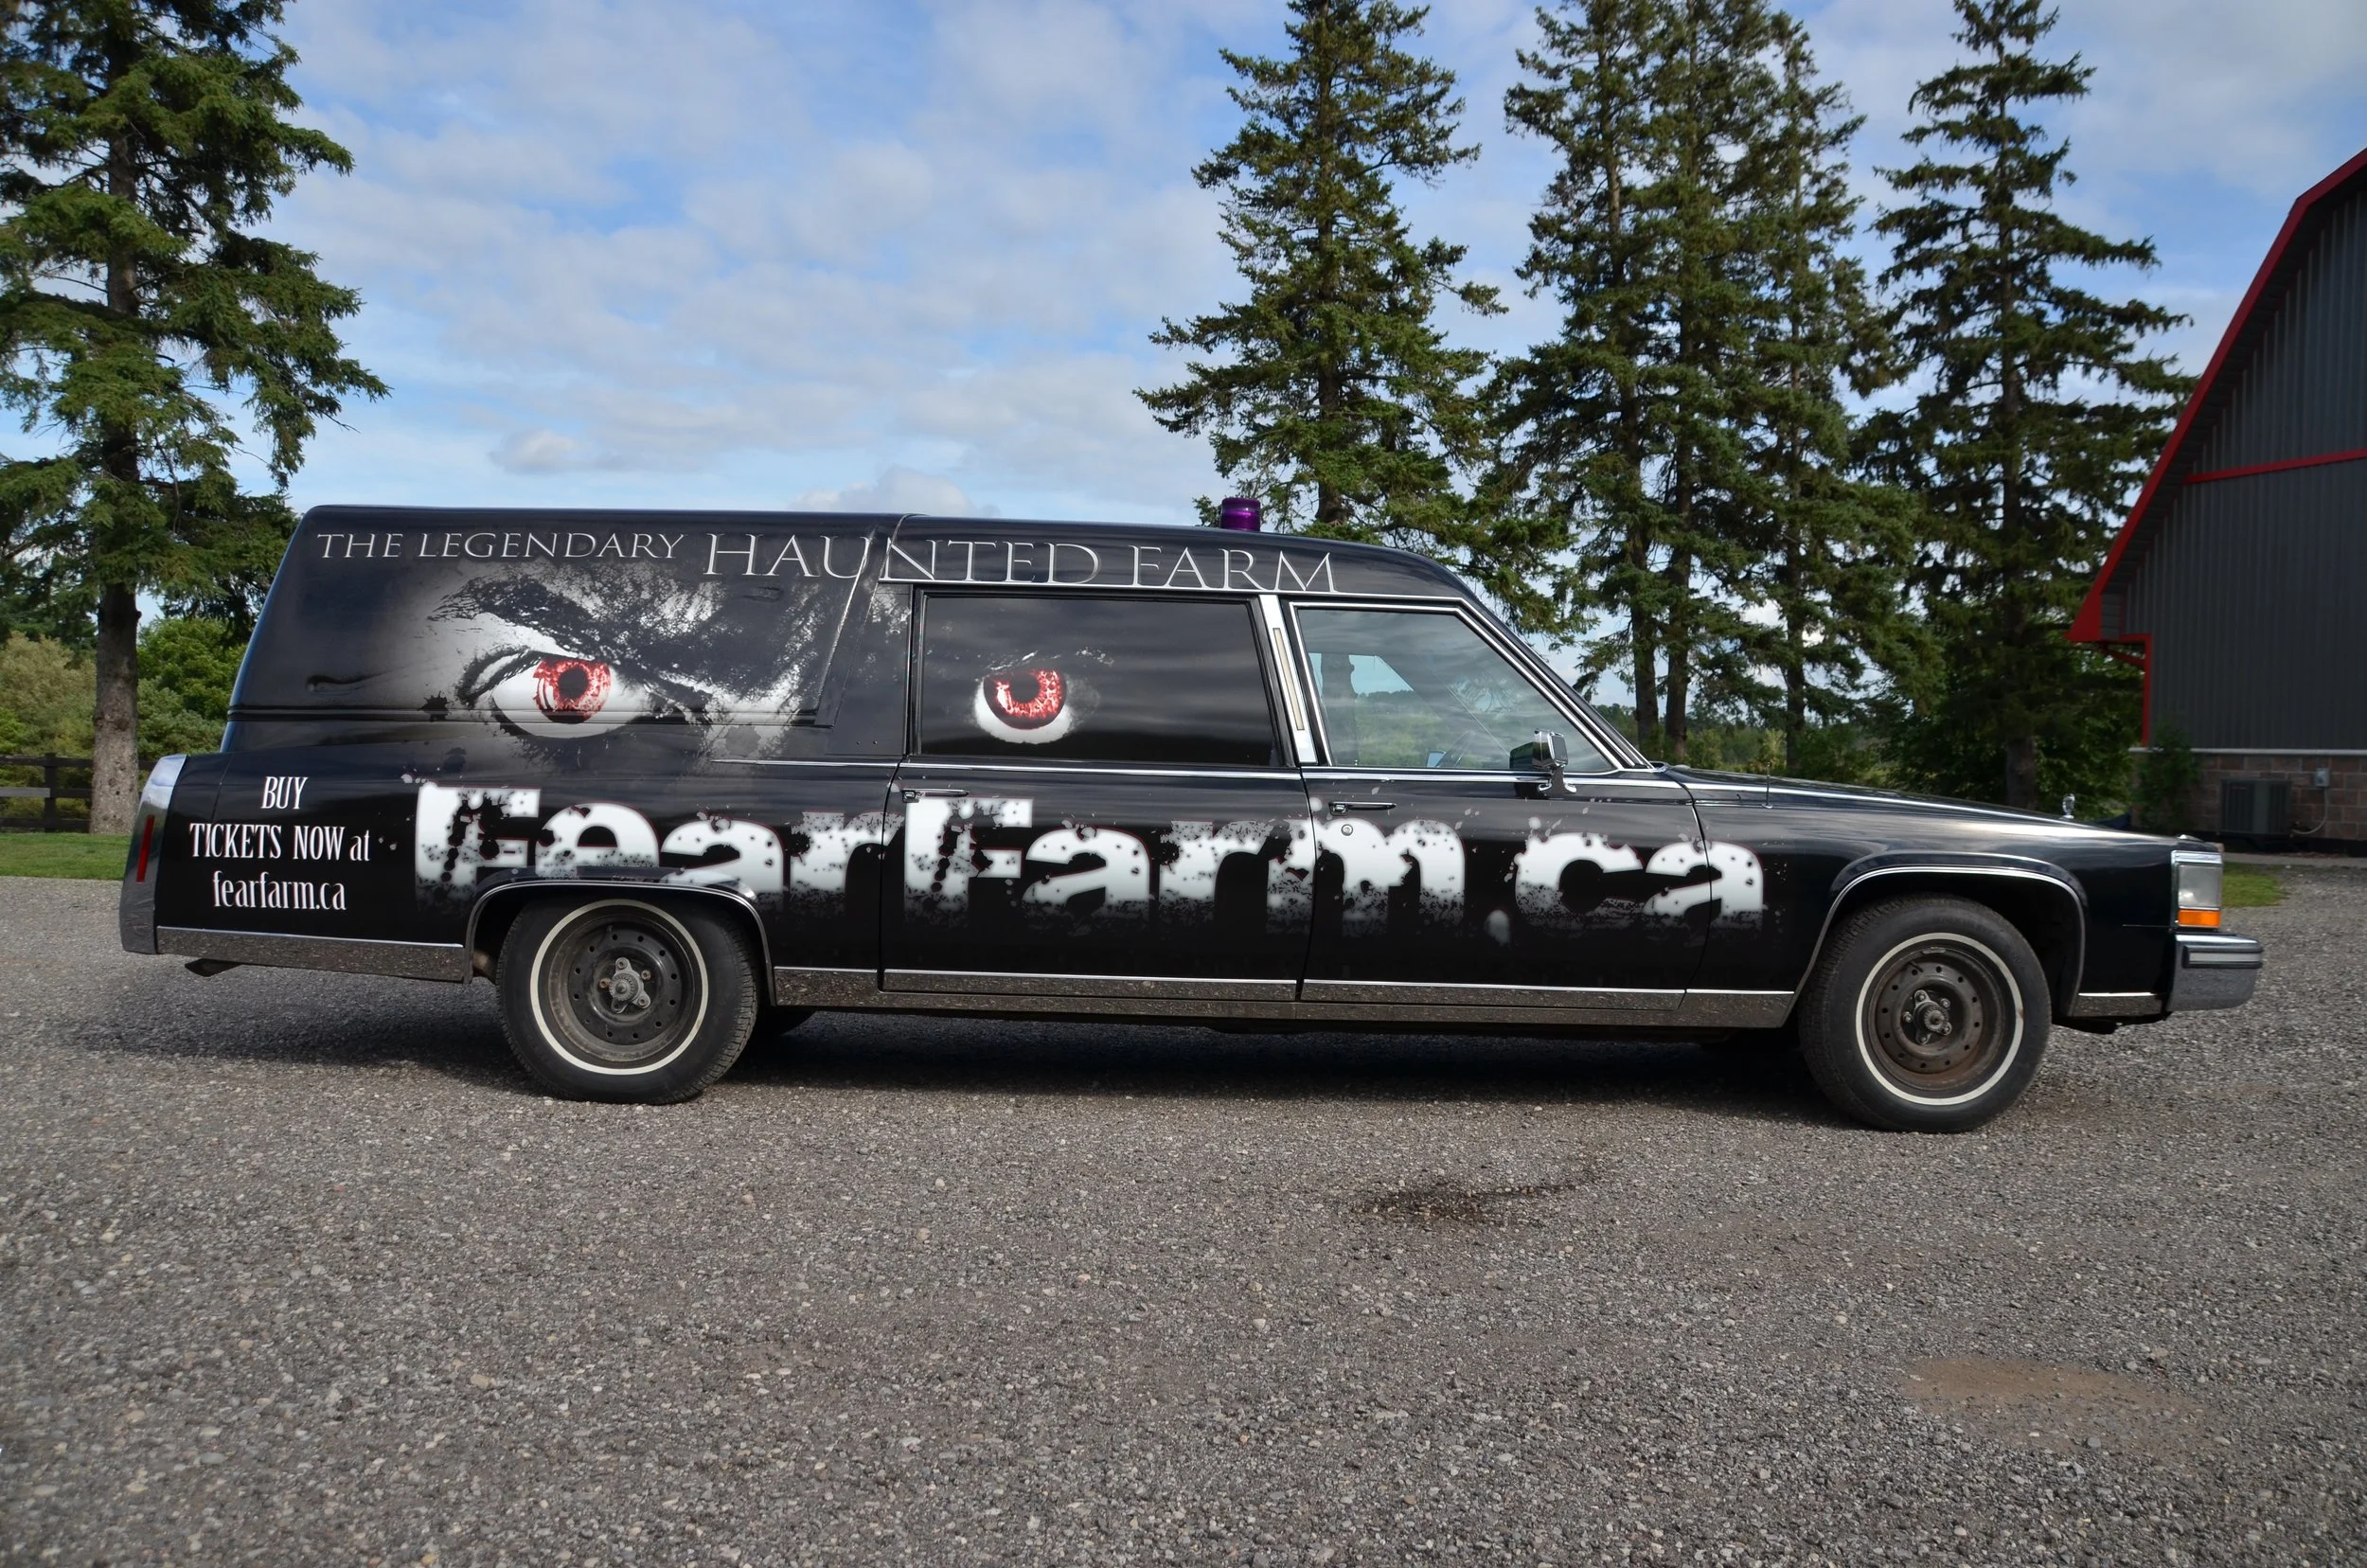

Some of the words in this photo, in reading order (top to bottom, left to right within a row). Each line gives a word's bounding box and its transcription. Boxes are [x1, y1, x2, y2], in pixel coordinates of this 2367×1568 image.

[317, 533, 403, 559] THE
[418, 532, 685, 560] LEGENDARY
[702, 533, 1101, 584] HAUNTED
[1129, 544, 1341, 593] FARM
[261, 776, 309, 810] BUY
[189, 822, 282, 859] TICKETS
[293, 825, 346, 861] NOW
[349, 829, 370, 861] at
[212, 870, 347, 910] fearfarm.ca
